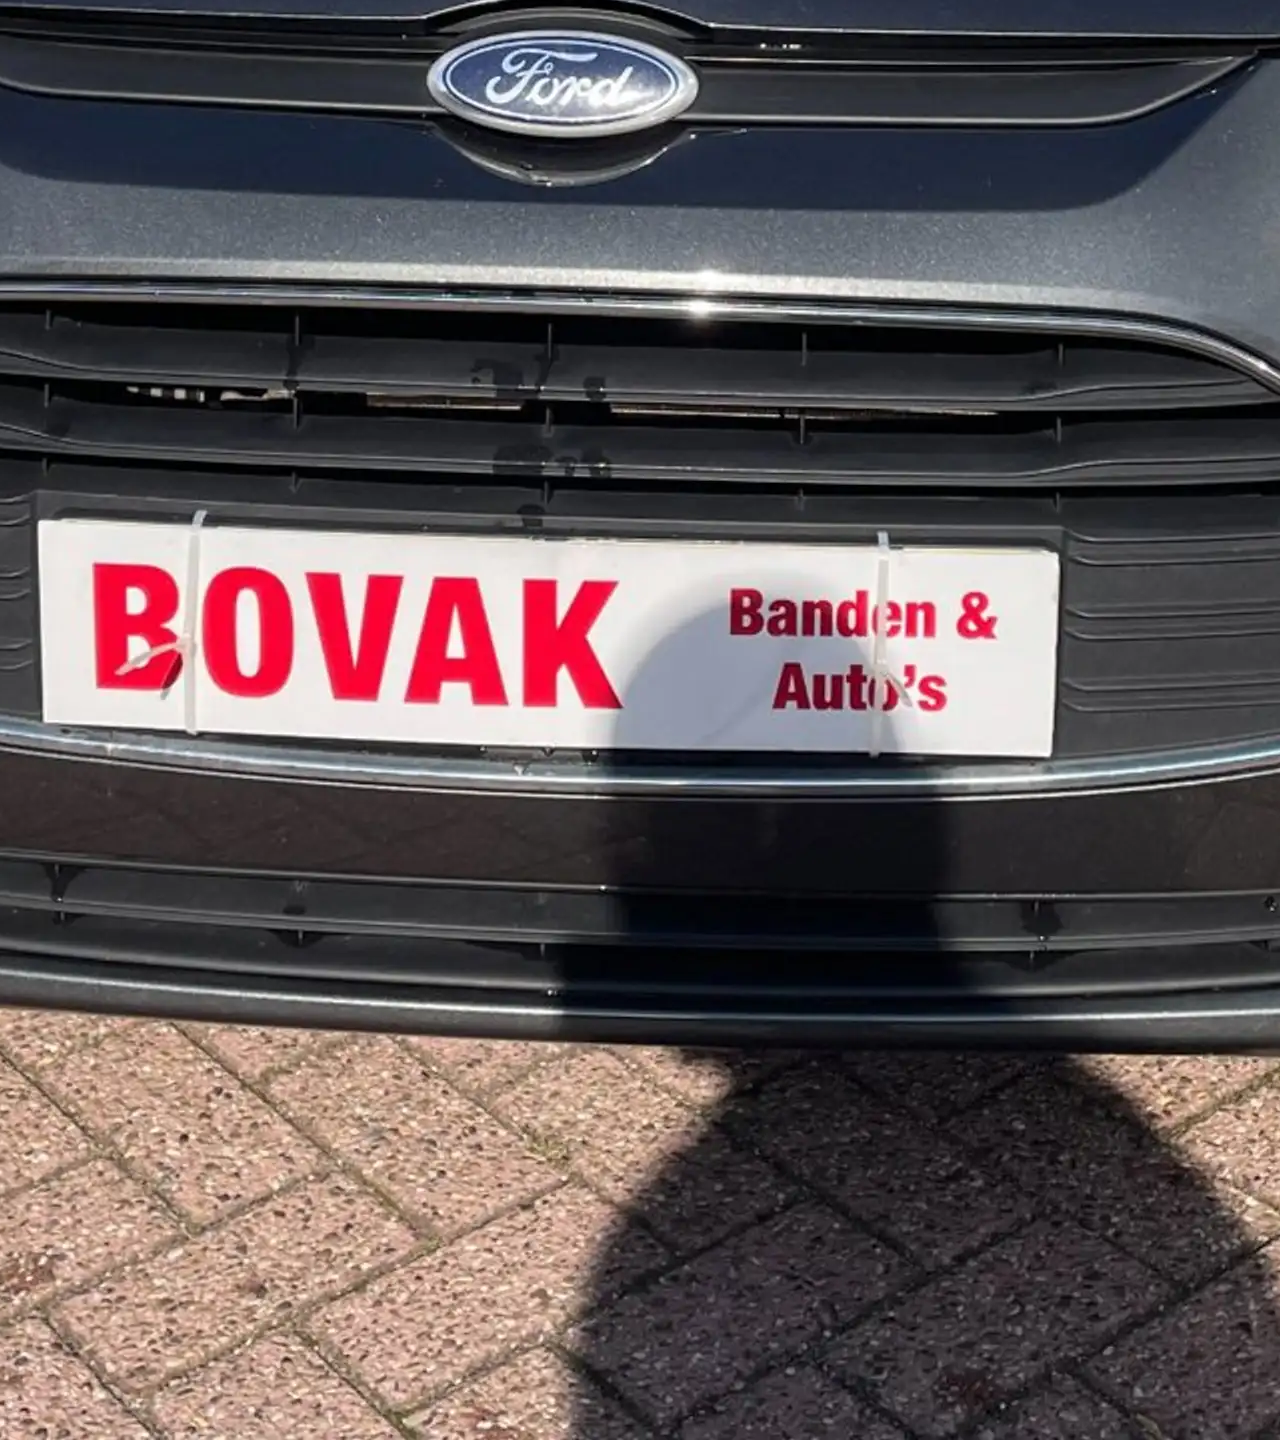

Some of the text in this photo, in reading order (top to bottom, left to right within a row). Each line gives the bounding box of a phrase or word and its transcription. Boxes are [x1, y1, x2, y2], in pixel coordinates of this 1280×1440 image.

[485, 47, 654, 108] Ford
[93, 561, 623, 710] BOVAK
[730, 588, 998, 639] Banden &
[773, 662, 948, 712] Auto's
